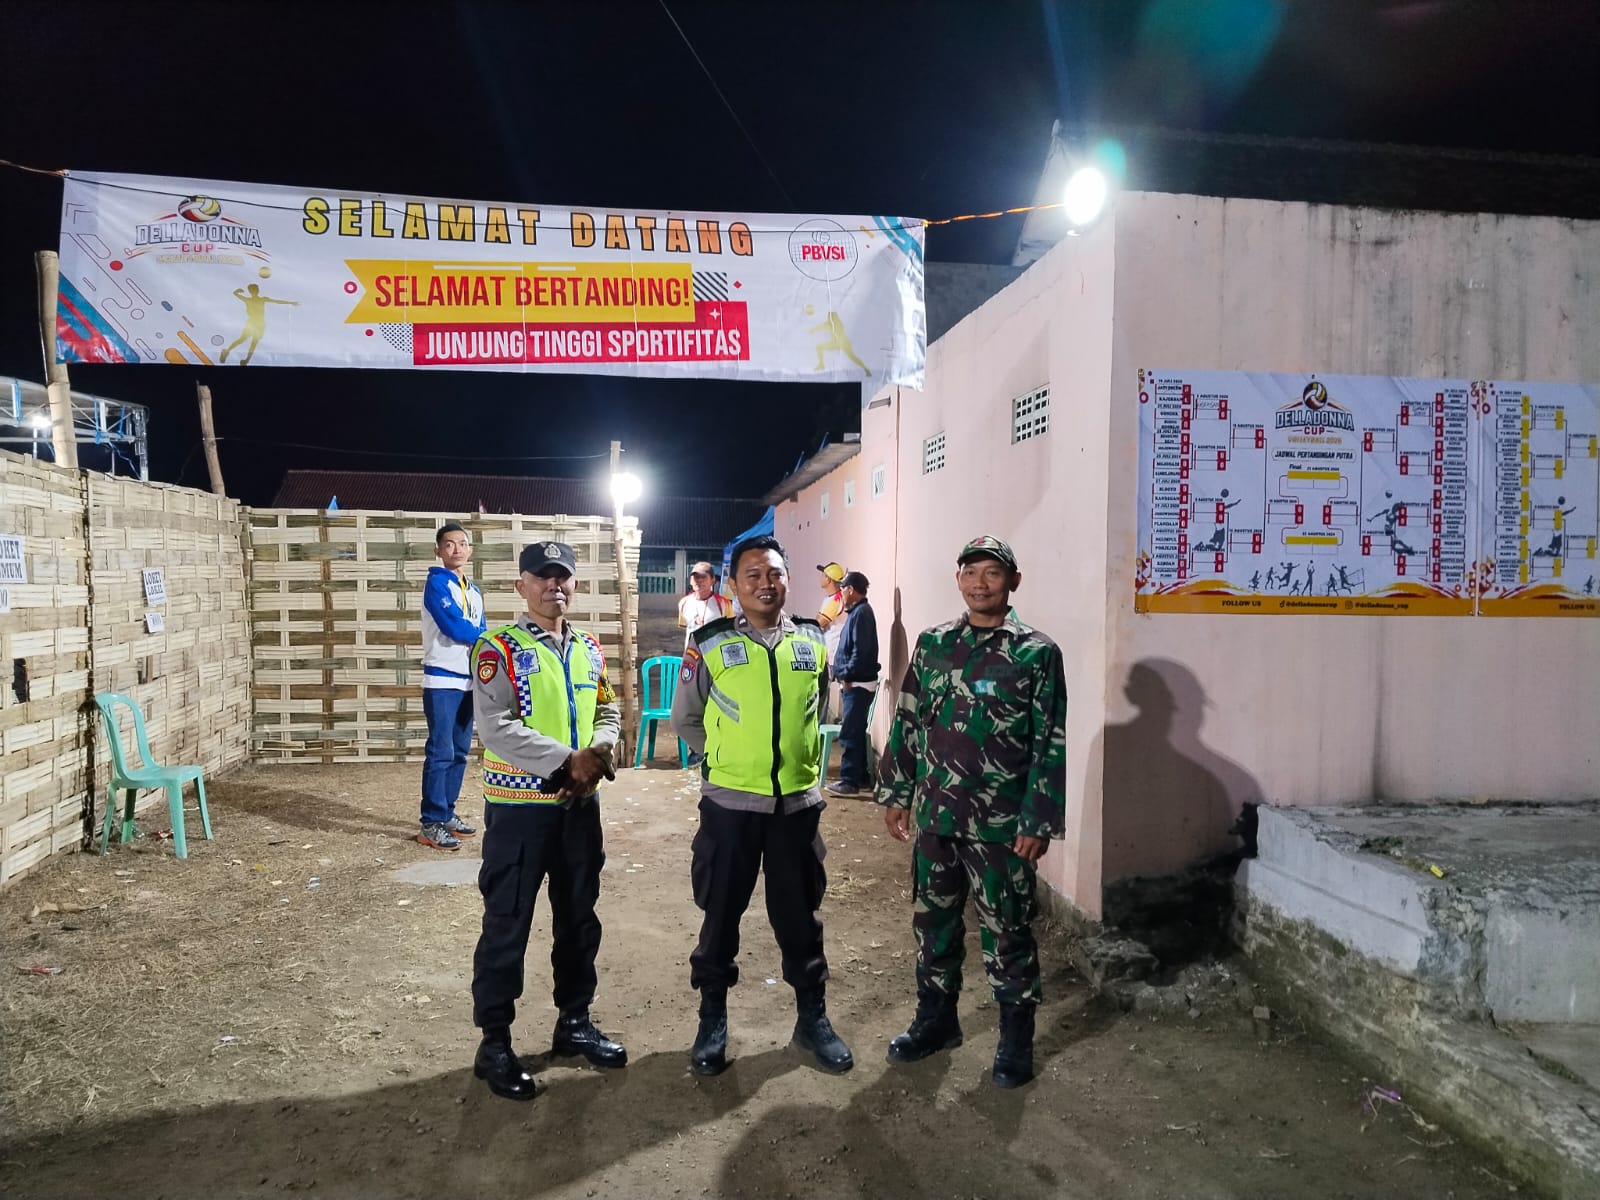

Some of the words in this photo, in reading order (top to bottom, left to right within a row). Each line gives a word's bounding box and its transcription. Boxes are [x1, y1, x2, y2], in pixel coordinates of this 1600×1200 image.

[136, 222, 262, 248] DELLADONNA
[302, 197, 540, 246] SELAMAT
[570, 212, 753, 256] DATANG
[181, 244, 215, 253] CUP
[801, 244, 845, 261] PBVSI
[375, 275, 506, 307] SELAMAT
[515, 277, 690, 307] BERTANDING!
[425, 331, 524, 359] JUNJUNG
[530, 330, 602, 358] TINGGI
[608, 330, 741, 357] SPORTIFITAS
[1275, 410, 1354, 431] DELLADONNA
[1304, 427, 1325, 435] CUP
[0, 563, 22, 578] MUM
